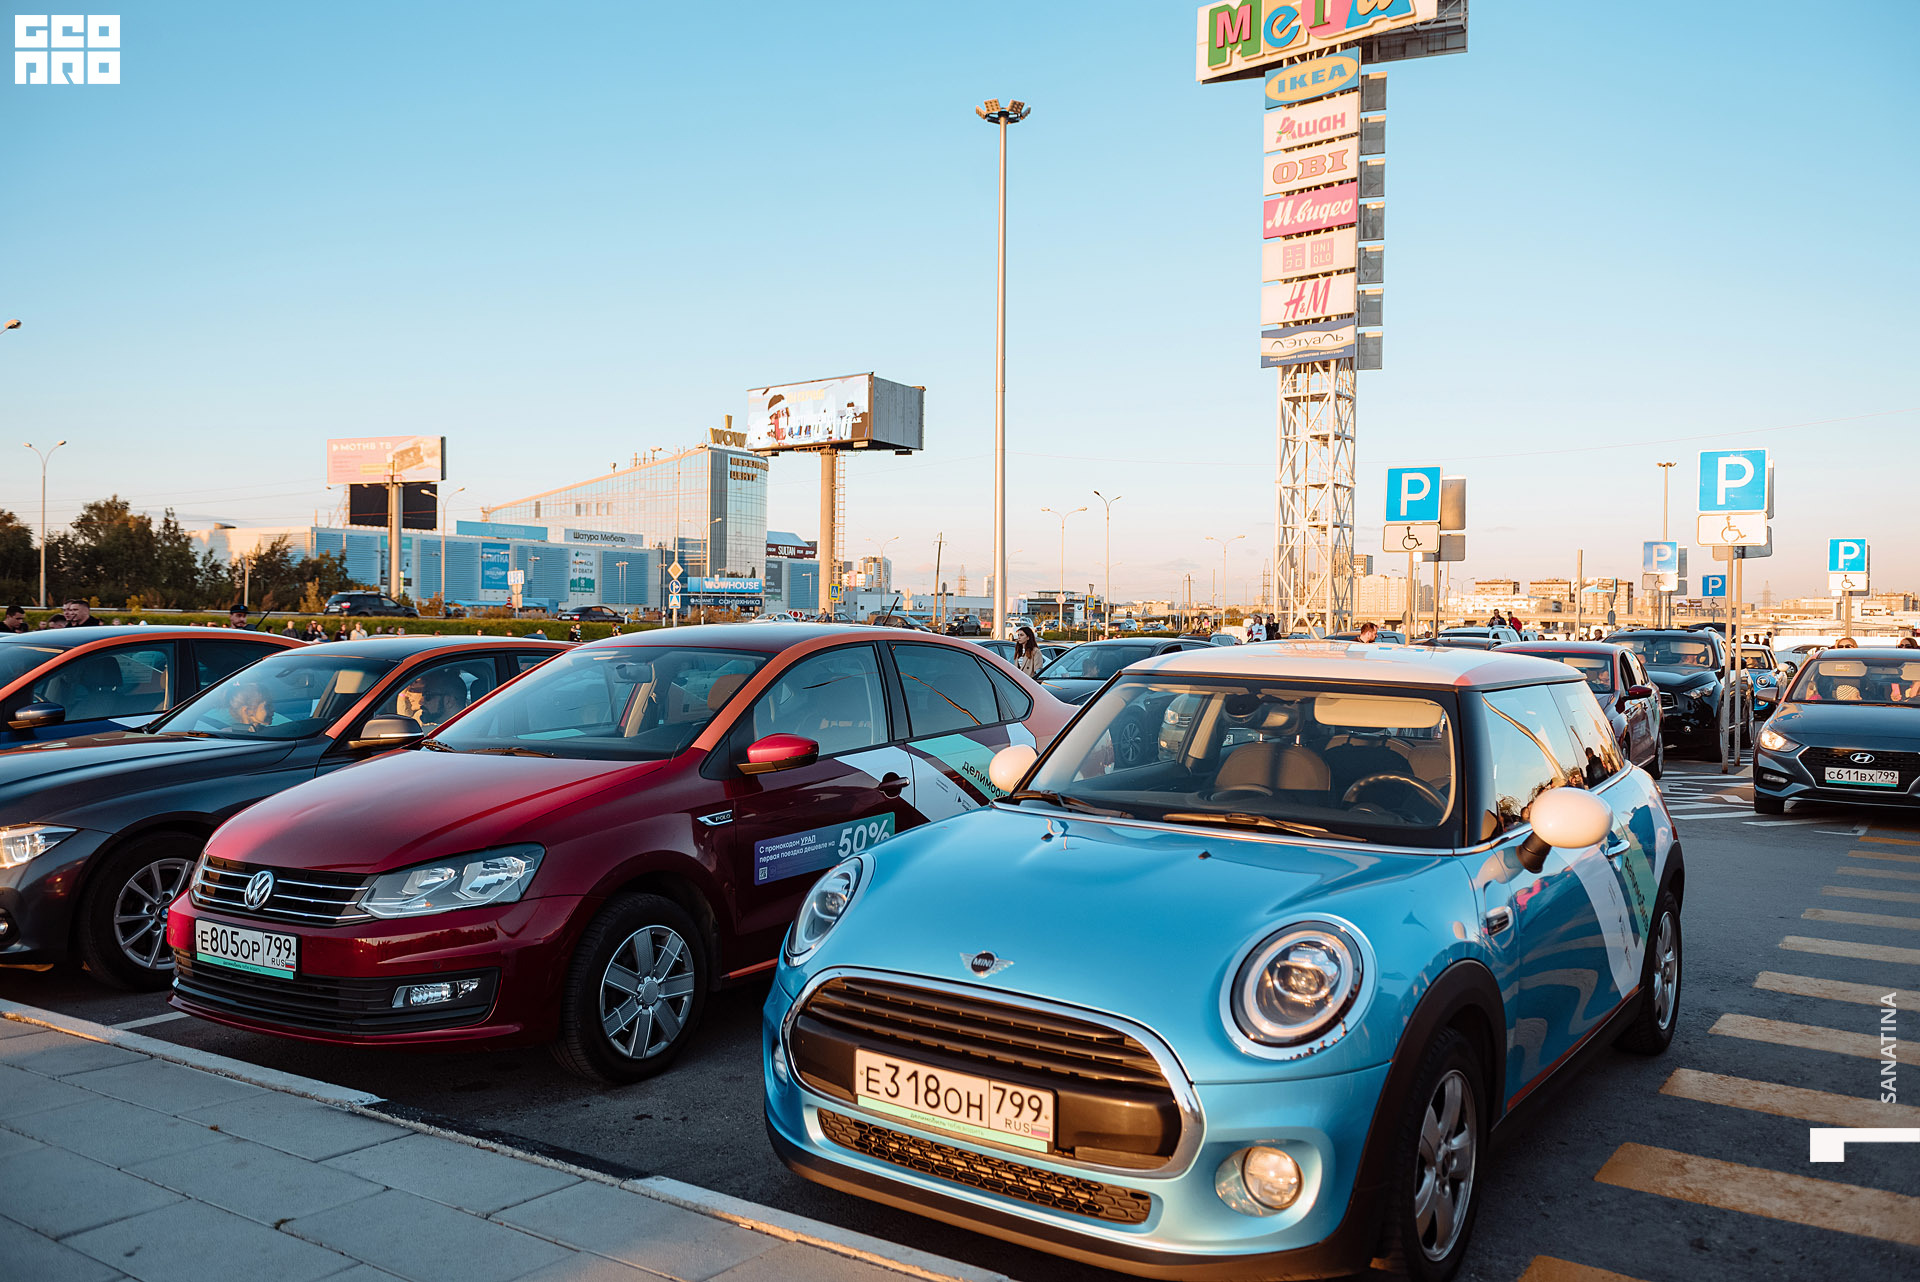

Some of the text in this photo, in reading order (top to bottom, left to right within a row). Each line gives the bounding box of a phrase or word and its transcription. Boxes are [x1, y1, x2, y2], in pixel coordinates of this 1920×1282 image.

[1277, 62, 1348, 94] IKEA
[1275, 110, 1347, 144] Ашан
[1272, 148, 1349, 186] OBI
[1265, 196, 1354, 230] М.видео
[1283, 278, 1332, 320] H&M
[379, 441, 392, 450] ТВ
[709, 427, 748, 448] WOW
[1716, 455, 1755, 505] P
[1400, 472, 1431, 517] P
[573, 531, 626, 543] Шатура Мебель
[777, 545, 796, 556] SULTAN
[1652, 544, 1672, 569] P
[1837, 541, 1860, 570] P
[1708, 576, 1724, 596] P
[1828, 769, 1875, 782] С611ВХ
[1877, 771, 1896, 780] 799
[759, 834, 816, 854] С промокодом УРАЛ
[837, 819, 891, 858] 50%
[759, 852, 780, 863] первая
[780, 847, 804, 858] поездка
[264, 935, 292, 960] 799
[271, 957, 285, 967] RUS
[973, 957, 994, 969] MINI
[865, 1063, 983, 1121] Е318ОН
[993, 1086, 1043, 1122] 799
[1004, 1118, 1030, 1132] RUS
